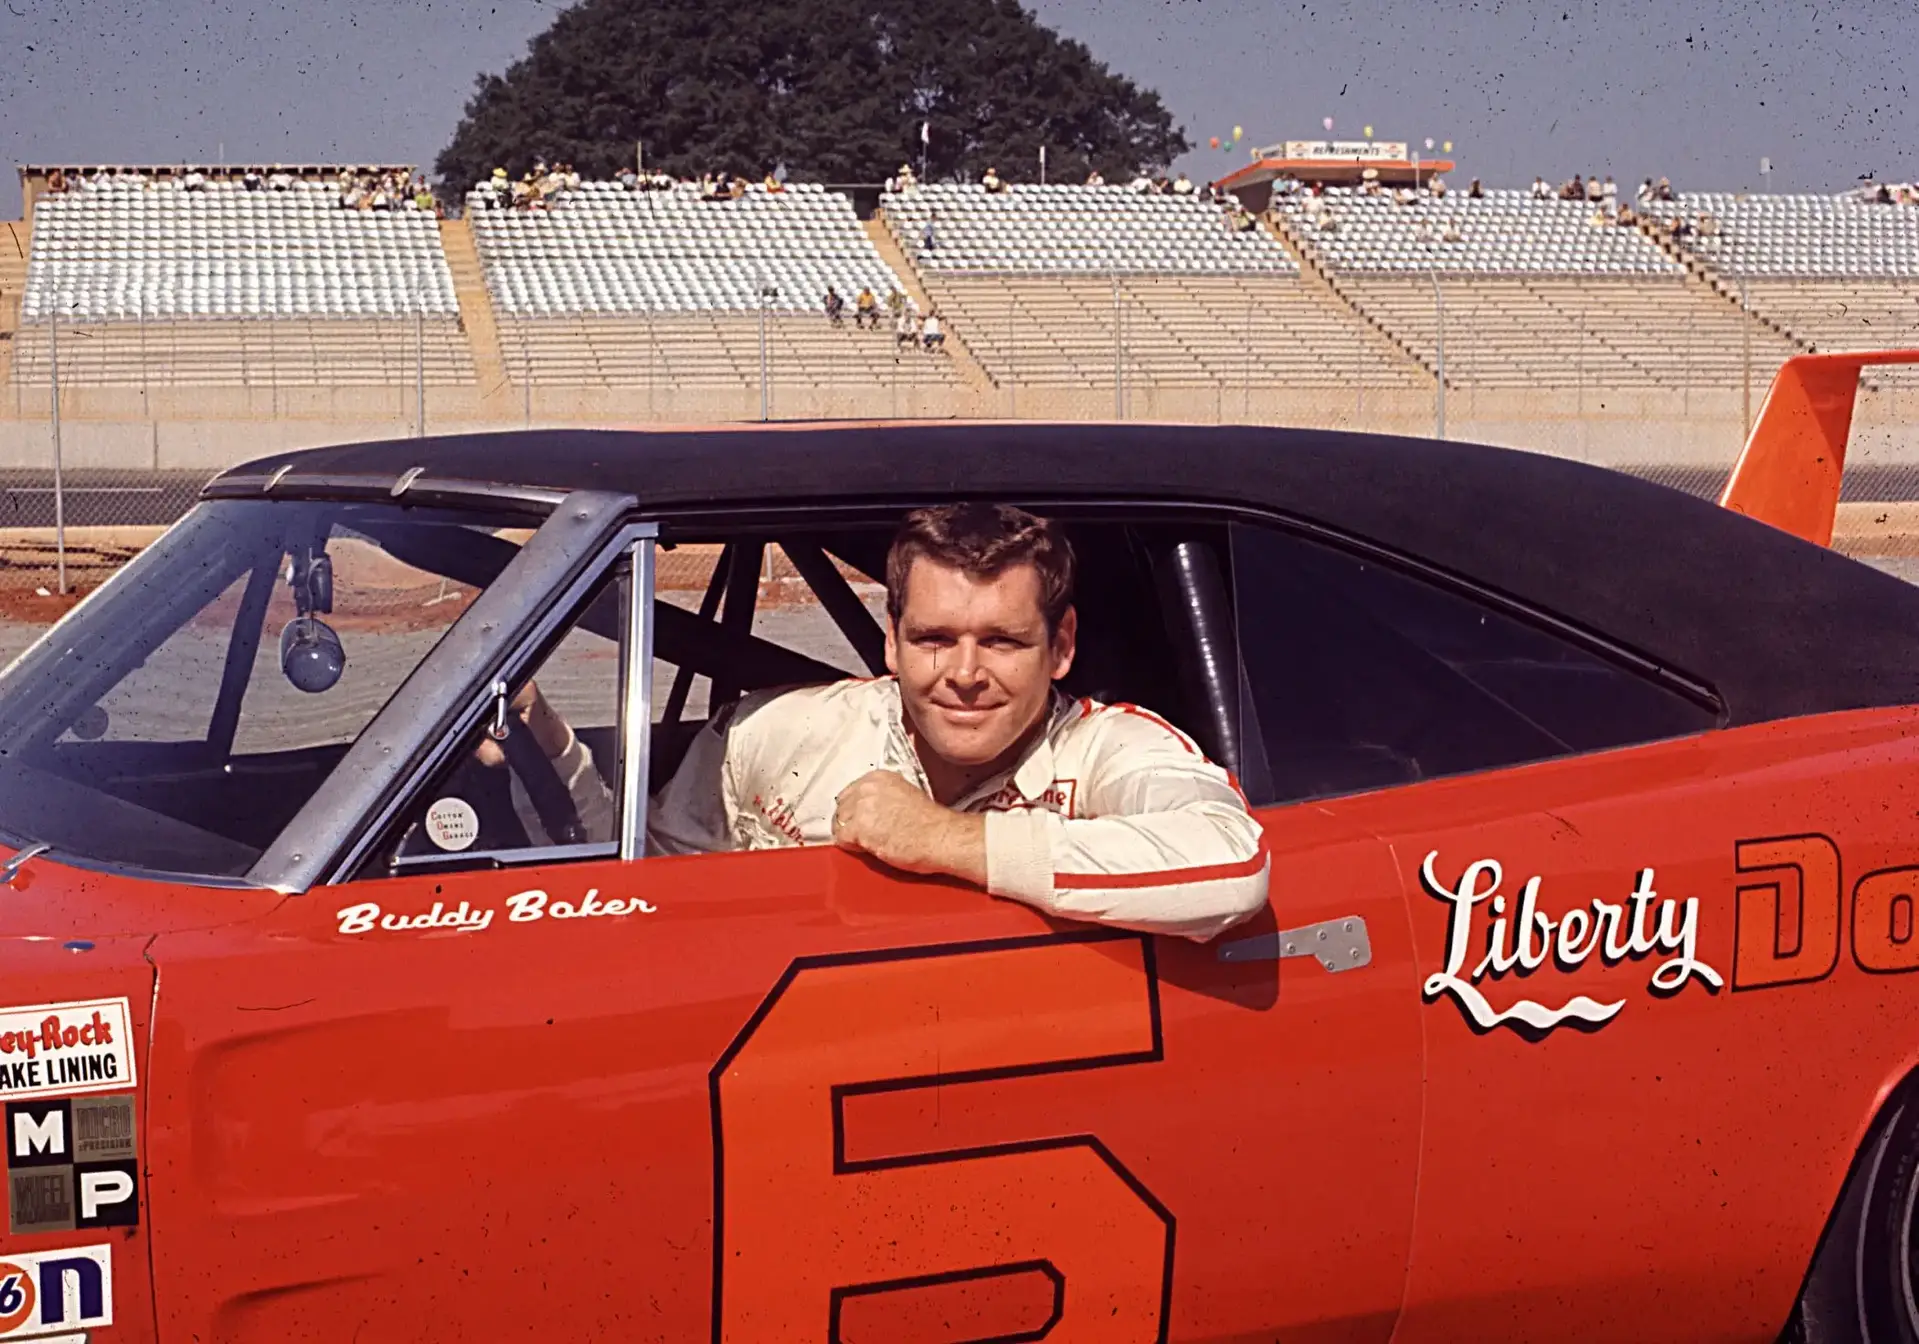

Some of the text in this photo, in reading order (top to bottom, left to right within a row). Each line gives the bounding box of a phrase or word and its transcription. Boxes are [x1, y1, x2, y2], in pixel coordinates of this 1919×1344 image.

[1312, 145, 1381, 156] REFRESHMENTS
[336, 888, 658, 934] Buddy Baker
[1419, 849, 1725, 1036] Liberty
[46, 1052, 118, 1085] LINING
[14, 1110, 65, 1157] M
[708, 928, 1176, 1344] 6
[80, 1170, 134, 1219] P
